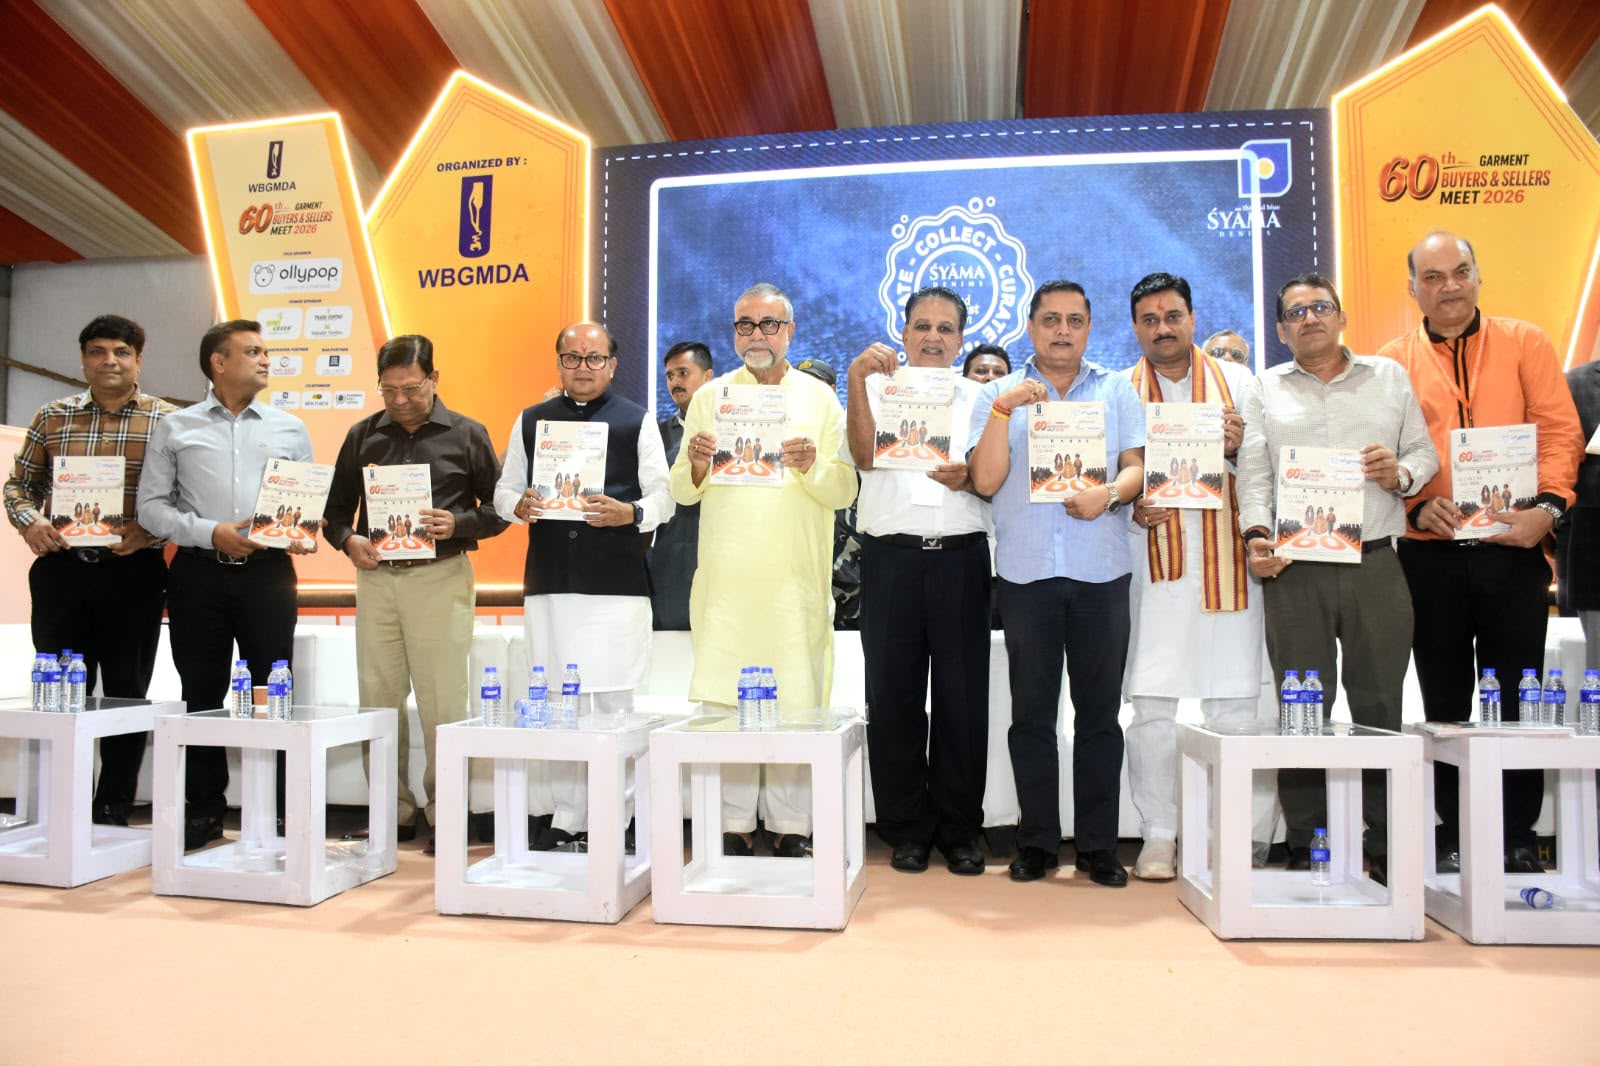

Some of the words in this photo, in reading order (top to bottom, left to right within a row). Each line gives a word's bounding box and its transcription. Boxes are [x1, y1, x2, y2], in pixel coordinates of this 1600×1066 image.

[436, 158, 503, 172] ORGANIZED
[506, 157, 521, 166] BY
[1479, 154, 1530, 167] GARMENT
[1441, 171, 1488, 188] BUYERS
[1490, 172, 1499, 187] &
[1501, 170, 1551, 187] SELLERS
[248, 181, 297, 193] WBGMDA
[1440, 190, 1480, 205] MEET
[1483, 189, 1525, 204] 2026
[294, 201, 323, 211] GARMENT
[272, 213, 299, 225] BUYERS
[304, 211, 333, 223] SELLERS
[270, 225, 293, 235] MEET
[294, 224, 317, 234] 2026
[915, 226, 998, 256] COLLECT
[279, 264, 338, 283] ollypop
[418, 263, 529, 289] WBGMDA
[981, 264, 1016, 344] CURATE
[885, 385, 898, 396] 60
[1034, 421, 1047, 431] 60
[1459, 451, 1473, 463] 60
[58, 473, 70, 483] 60
[1286, 468, 1301, 479] 60
[369, 485, 380, 495] 60
